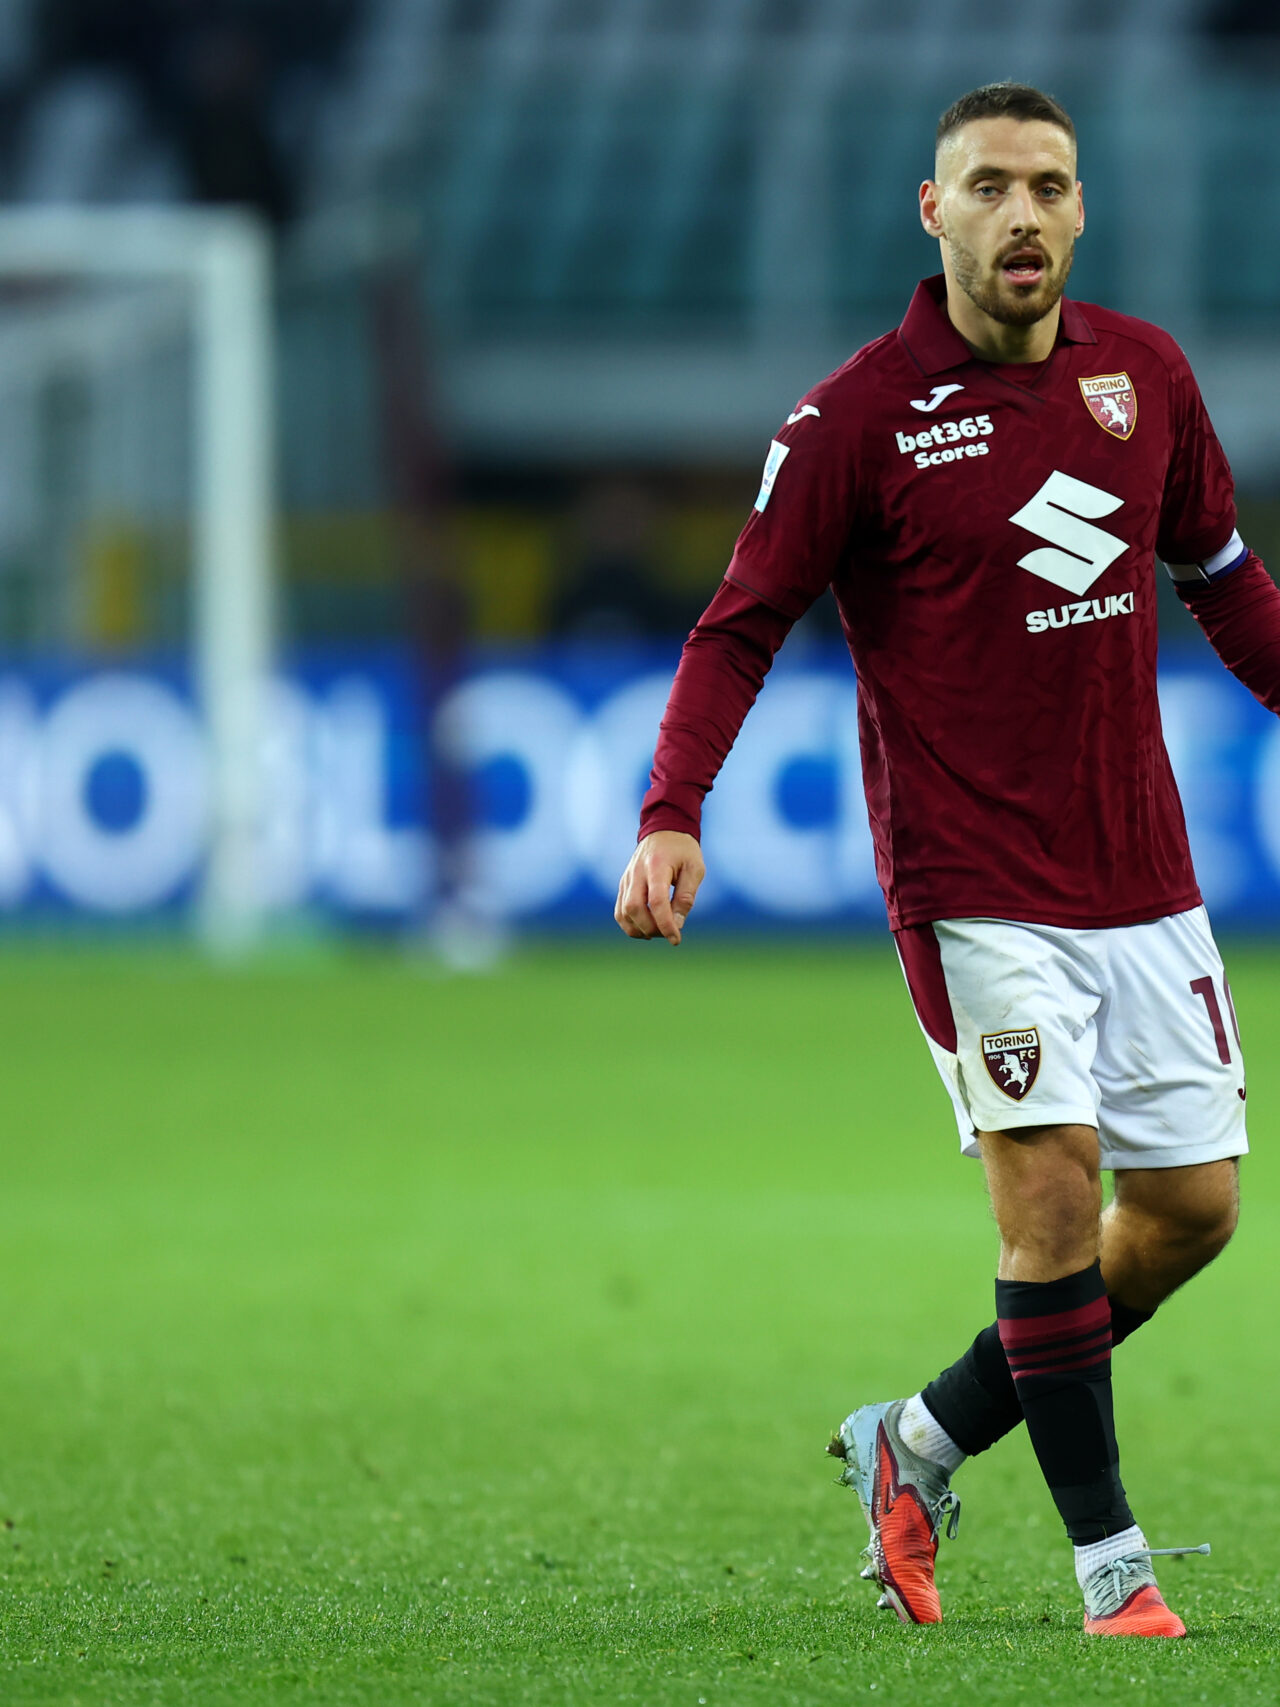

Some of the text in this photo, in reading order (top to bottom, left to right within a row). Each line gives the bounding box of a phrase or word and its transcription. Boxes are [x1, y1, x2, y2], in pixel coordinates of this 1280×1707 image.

[1085, 378, 1126, 393] TORINO
[1114, 392, 1131, 404] FC
[895, 414, 994, 454] bet365
[914, 441, 990, 469] Scores
[1025, 591, 1135, 634] SUZUKI
[1189, 972, 1241, 1066] 1
[986, 1033, 1034, 1050] TORINO
[1019, 1048, 1037, 1061] FC
